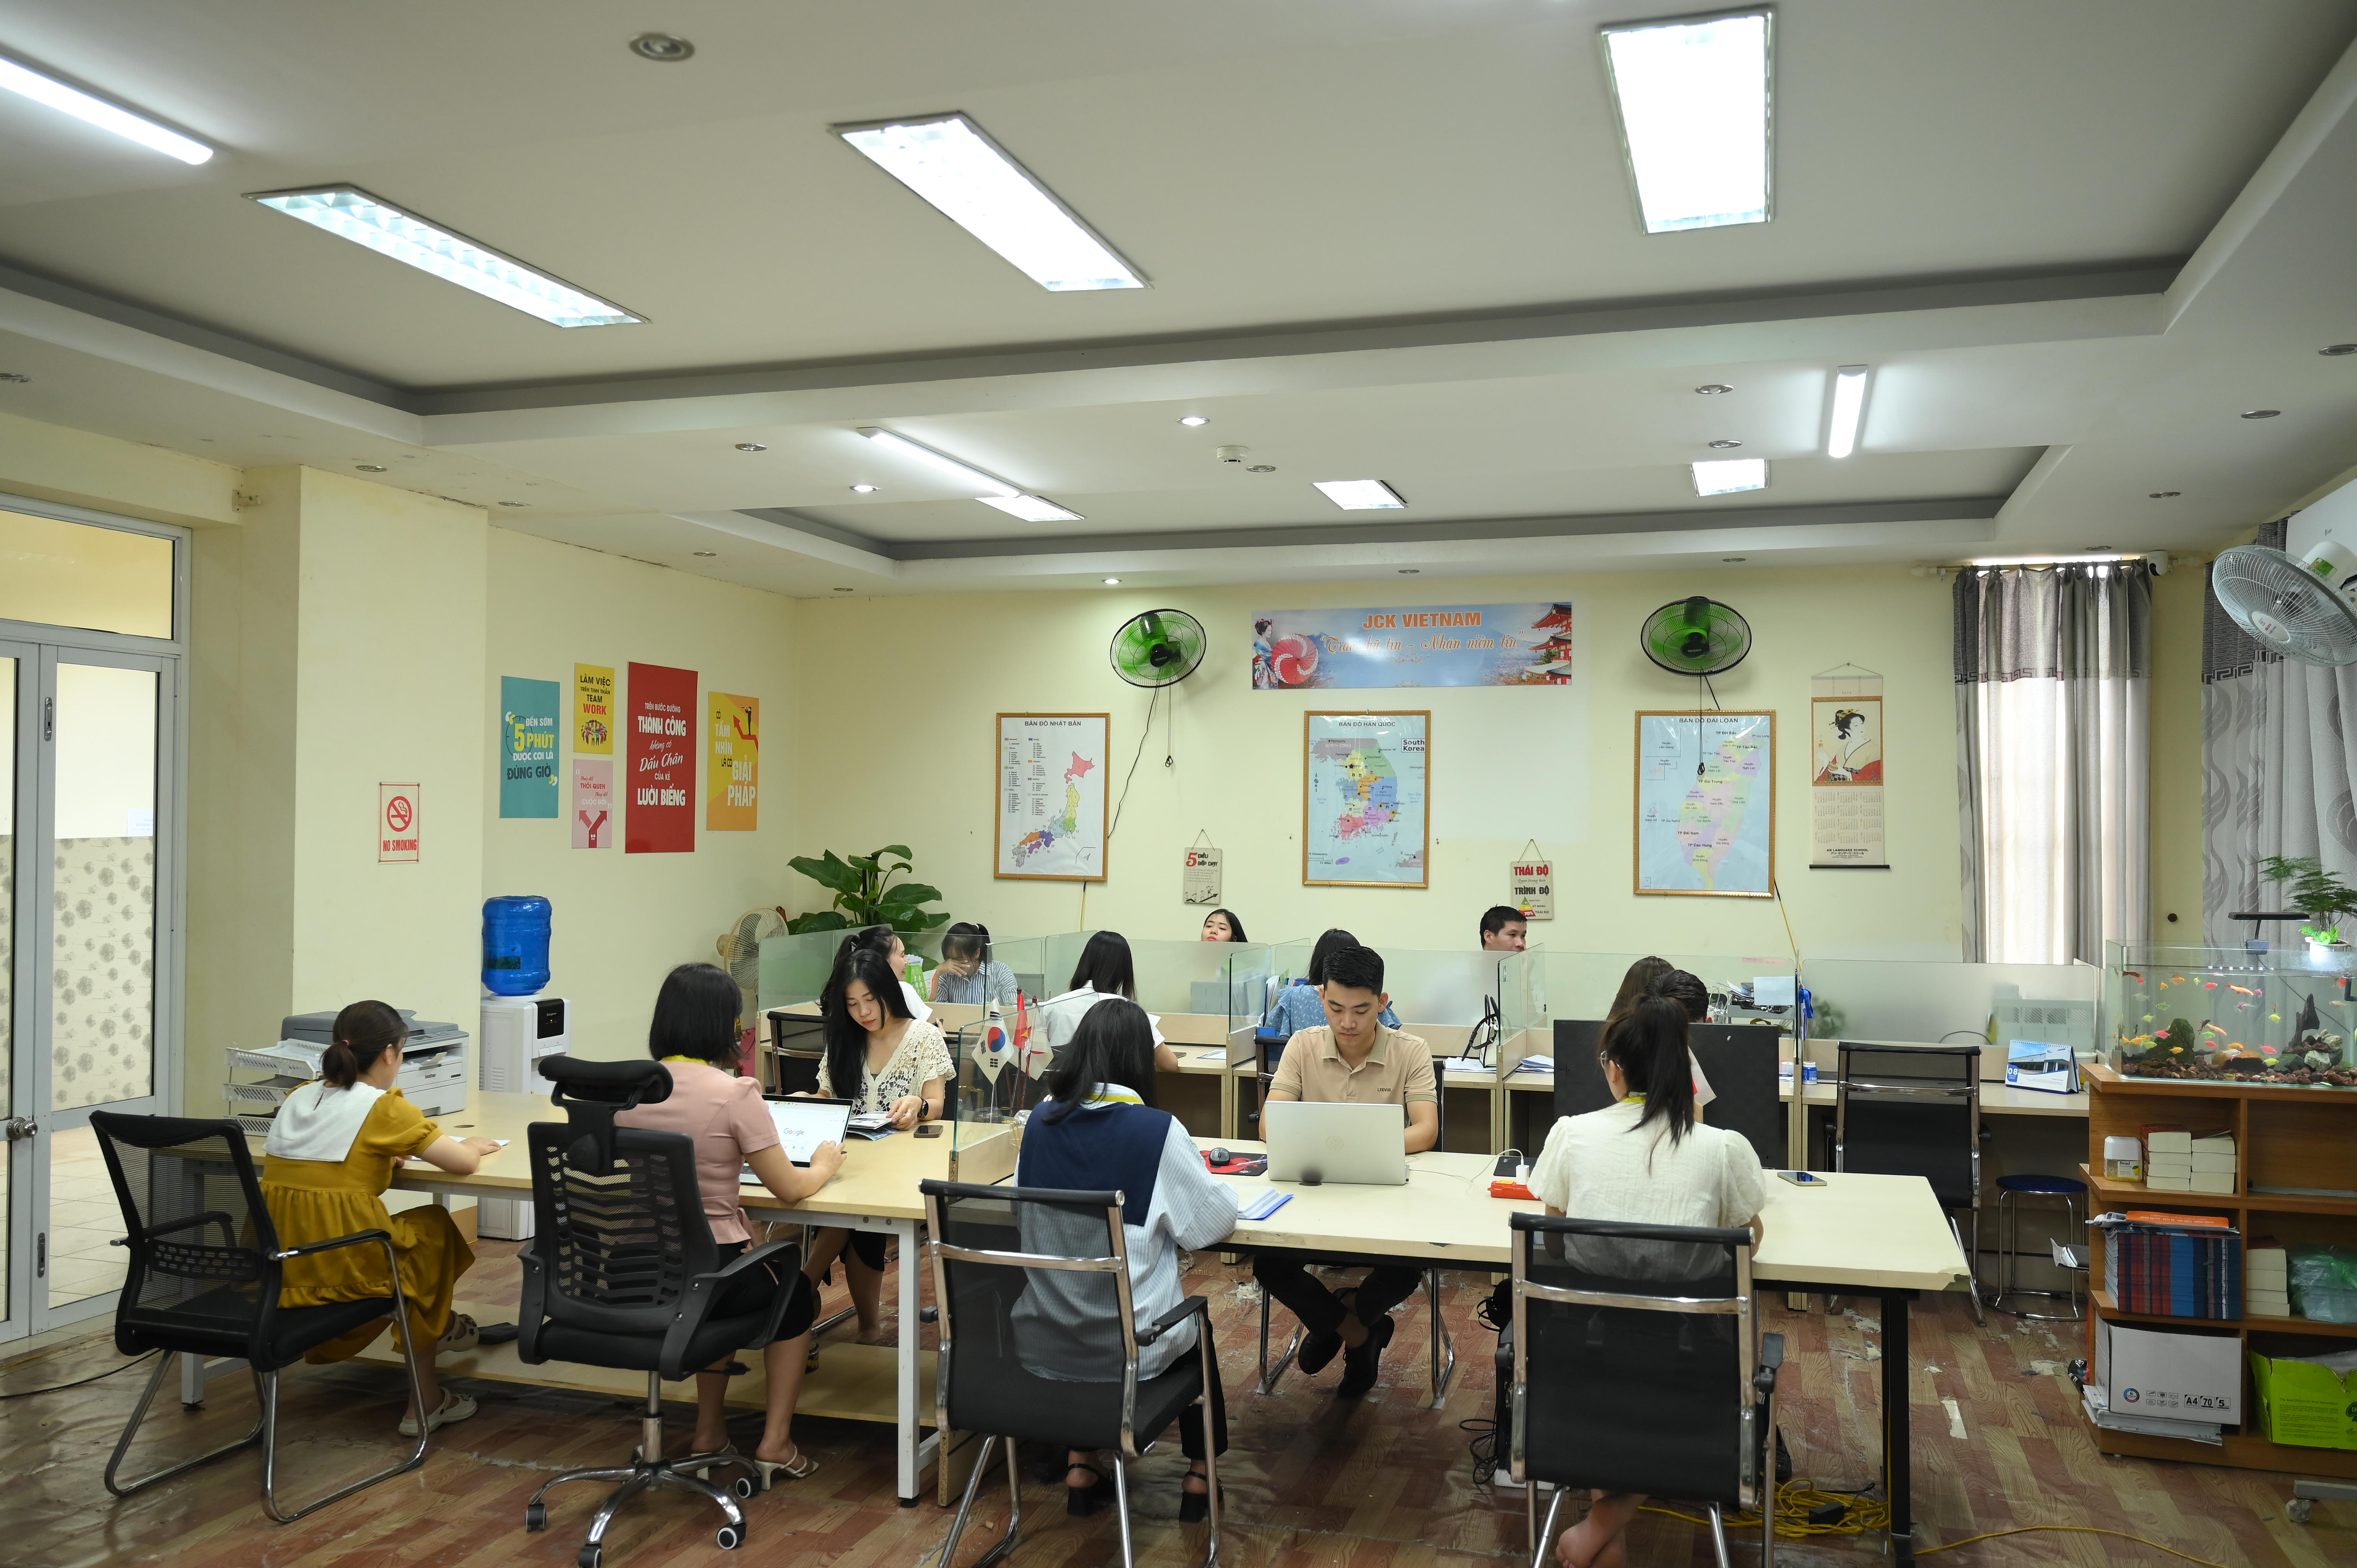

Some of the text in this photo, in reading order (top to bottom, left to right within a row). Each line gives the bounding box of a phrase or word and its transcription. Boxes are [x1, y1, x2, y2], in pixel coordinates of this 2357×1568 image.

[1363, 612, 1481, 629] JCK VIETNAM
[1386, 638, 1401, 650] tín
[1421, 634, 1461, 652] Nhận
[1467, 635, 1494, 649] niềm
[580, 673, 611, 688] LÀM VIỆC
[587, 694, 603, 703] TEAM
[583, 703, 606, 715] WORK
[645, 701, 681, 713] TRÊN BƯỚC ĐƯỜNG
[526, 715, 553, 726] ĐẾN SỚM
[716, 710, 721, 719] CÓ
[638, 713, 686, 736] THÀNH CÔNG
[514, 723, 555, 751] 5 PHÚT
[650, 740, 672, 752] không có
[715, 739, 733, 754] NHÌN
[513, 752, 531, 763] ĐƯỢC
[546, 750, 553, 759] LÀ
[640, 752, 683, 772] Dấu Chân
[721, 756, 732, 767] LÀ CÓ
[507, 763, 551, 780] ĐÚNG GIỜ
[732, 754, 752, 781] GIẢI
[655, 771, 670, 780] CỦA KẺ
[638, 783, 686, 807] LƯỜI BIẾNG
[728, 781, 756, 806] PHÁP
[582, 798, 597, 806] CUỘC
[383, 839, 417, 851] NO SMOKING
[1186, 852, 1198, 867] 5
[1514, 864, 1549, 876] THÁI ĐỘ
[1514, 885, 1549, 896] TRÌNH ĐỘ
[784, 1128, 804, 1136] Google
